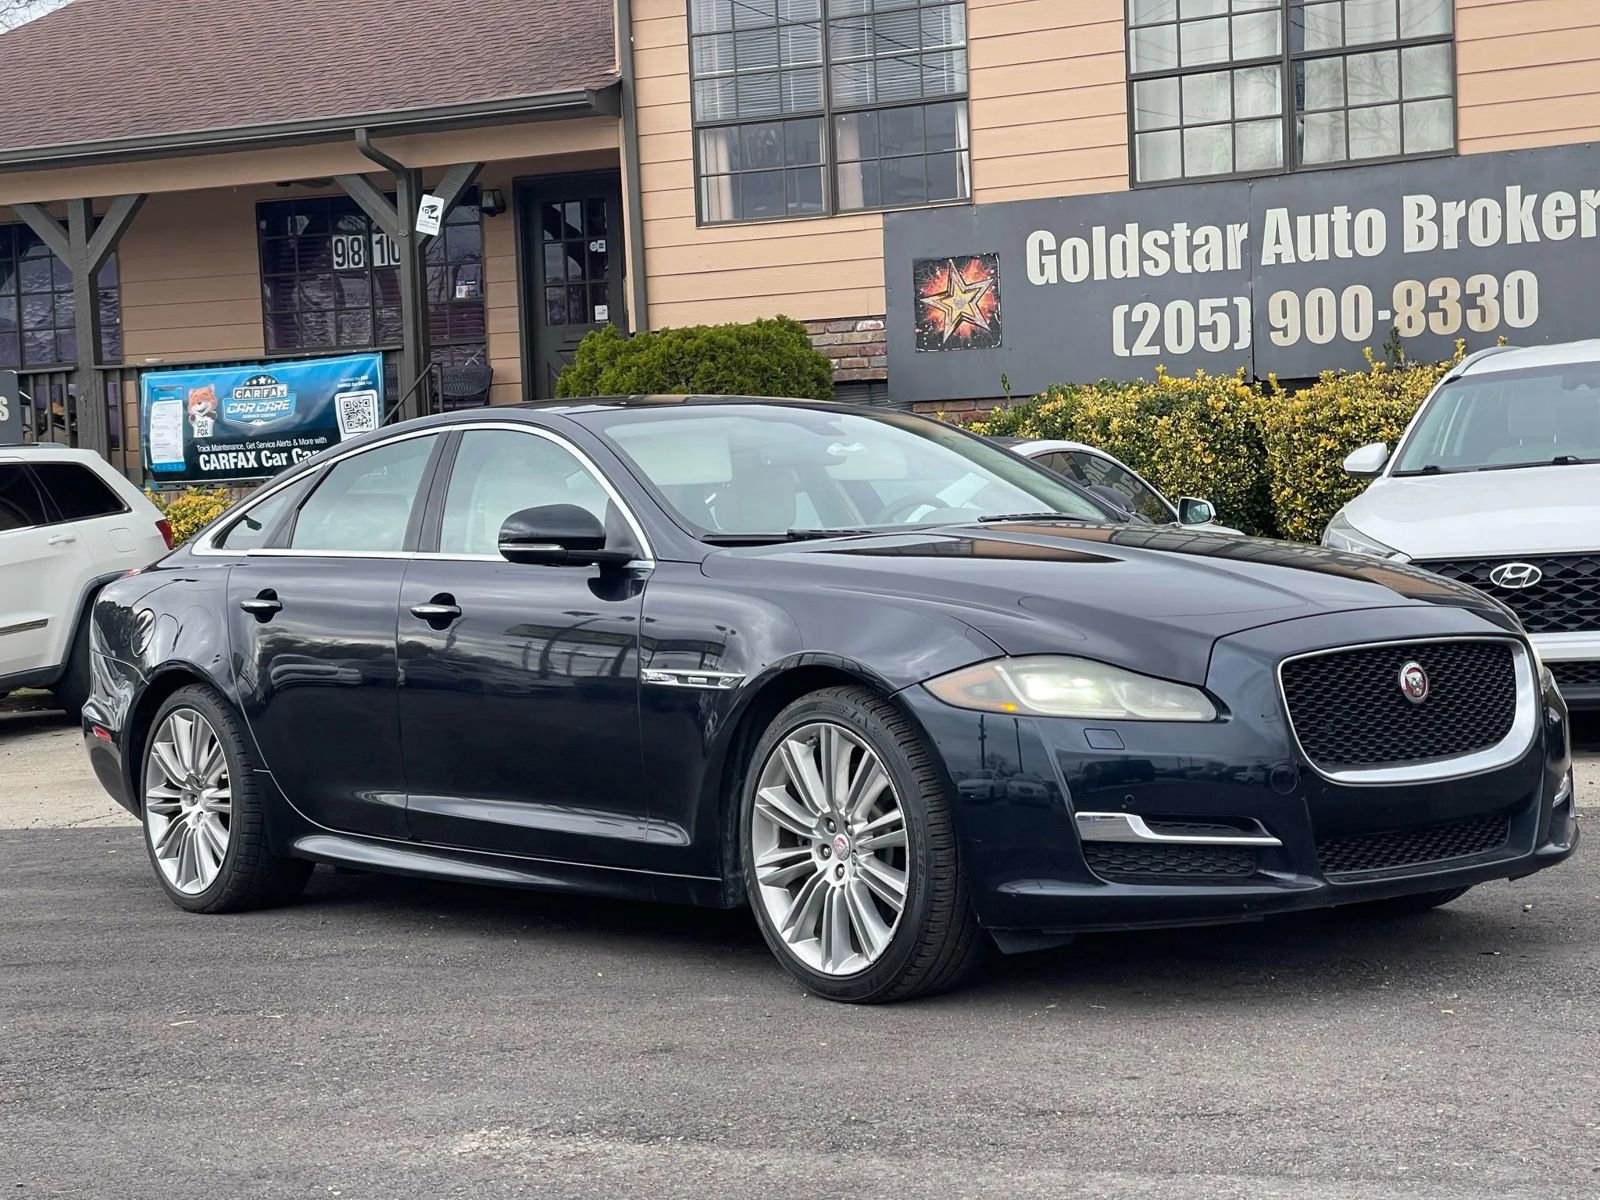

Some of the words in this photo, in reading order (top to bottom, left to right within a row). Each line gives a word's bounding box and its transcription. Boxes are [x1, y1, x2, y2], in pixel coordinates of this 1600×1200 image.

[1026, 222, 1249, 286] Goldstar
[1261, 205, 1387, 266] Auto
[1112, 296, 1251, 357] (205)
[1268, 270, 1539, 347] 900-8330
[235, 387, 287, 400] CARFAX
[227, 402, 256, 414] CAR
[256, 400, 291, 413] CARE
[197, 420, 208, 428] CAR
[197, 428, 209, 436] FOX
[197, 444, 211, 453] Track
[211, 442, 246, 452] Maintenance,
[246, 441, 256, 450] Get
[256, 440, 276, 449] Service
[276, 438, 292, 448] Alerts
[292, 438, 298, 446] &
[298, 438, 314, 446] More
[314, 436, 328, 444] with
[199, 450, 259, 471] CARFAX
[260, 449, 288, 467] Car
